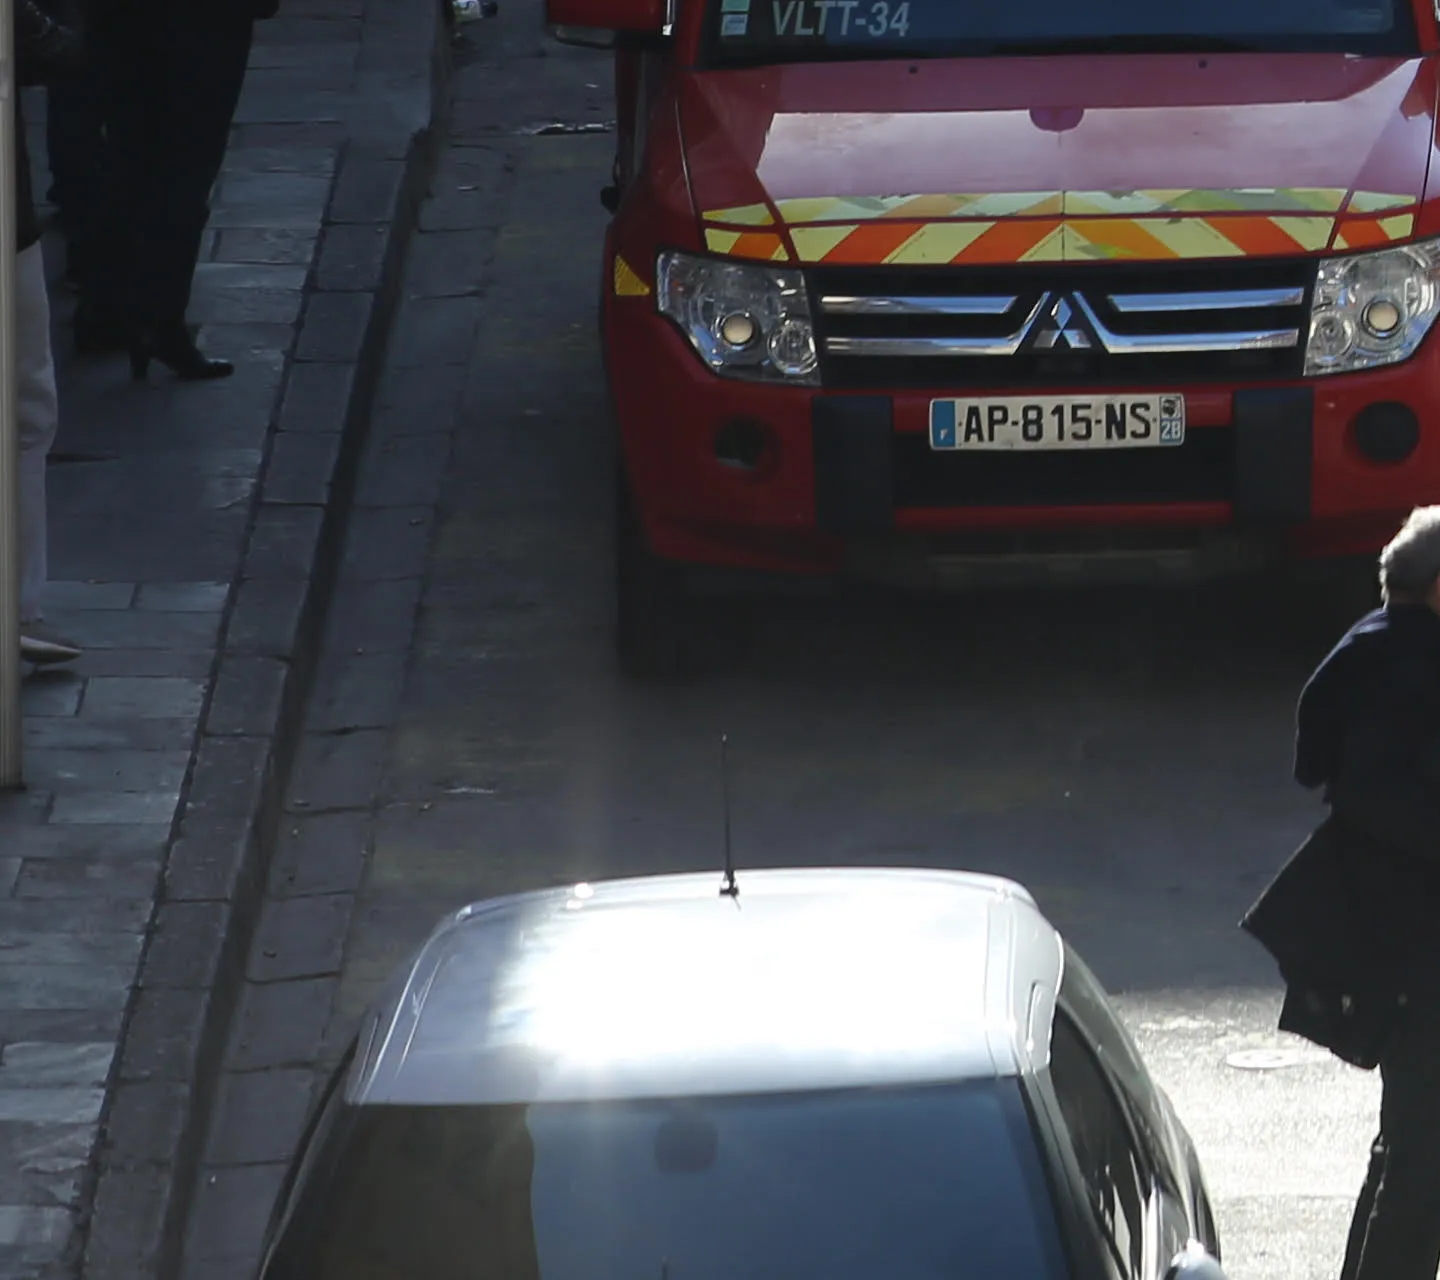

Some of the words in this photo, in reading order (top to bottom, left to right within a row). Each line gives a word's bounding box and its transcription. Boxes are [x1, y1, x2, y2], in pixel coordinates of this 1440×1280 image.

[772, 0, 911, 38] VLTT-34
[963, 402, 1152, 442] AP-815-NS
[1160, 420, 1182, 441] 2B
